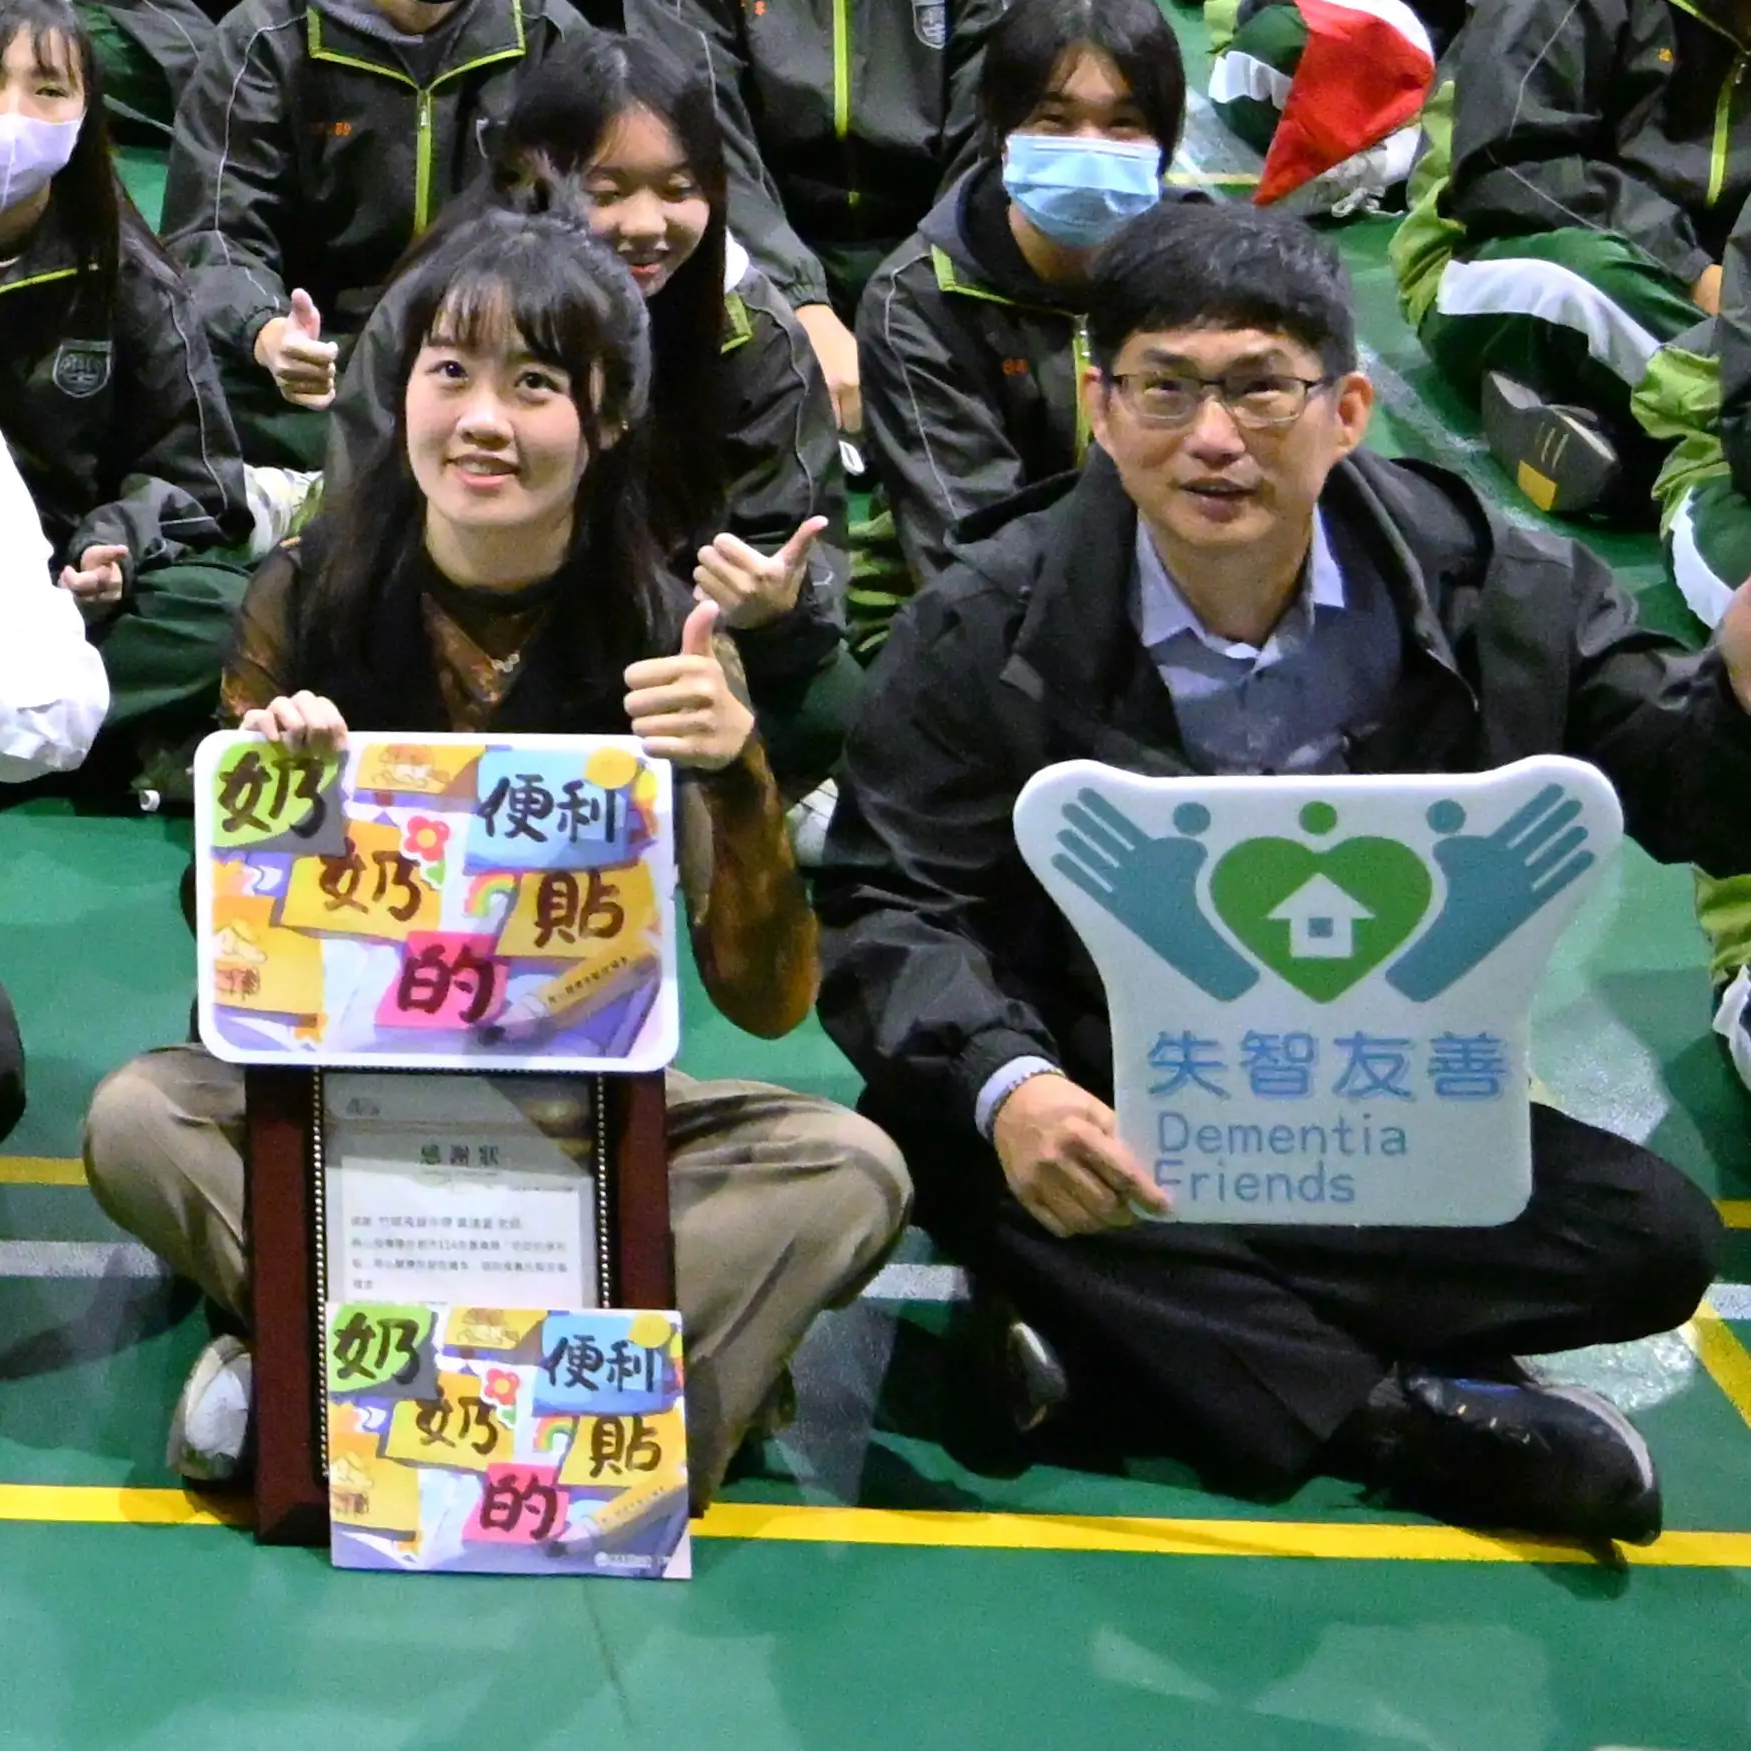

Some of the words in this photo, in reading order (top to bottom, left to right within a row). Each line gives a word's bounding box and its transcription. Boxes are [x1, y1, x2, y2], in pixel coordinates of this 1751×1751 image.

[217, 749, 327, 839] 奶
[475, 773, 618, 844] 便利
[317, 838, 423, 921] 奶
[534, 868, 625, 949] 貼
[396, 943, 497, 1025] 的
[1146, 1028, 1510, 1103] 失智友善
[1157, 1111, 1409, 1157] Dementia
[1153, 1157, 1357, 1205] Friends
[333, 1311, 421, 1385] 奶
[544, 1334, 657, 1394] 便利
[415, 1385, 499, 1456] 奶
[589, 1413, 663, 1479] 貼
[479, 1473, 559, 1541] 的
